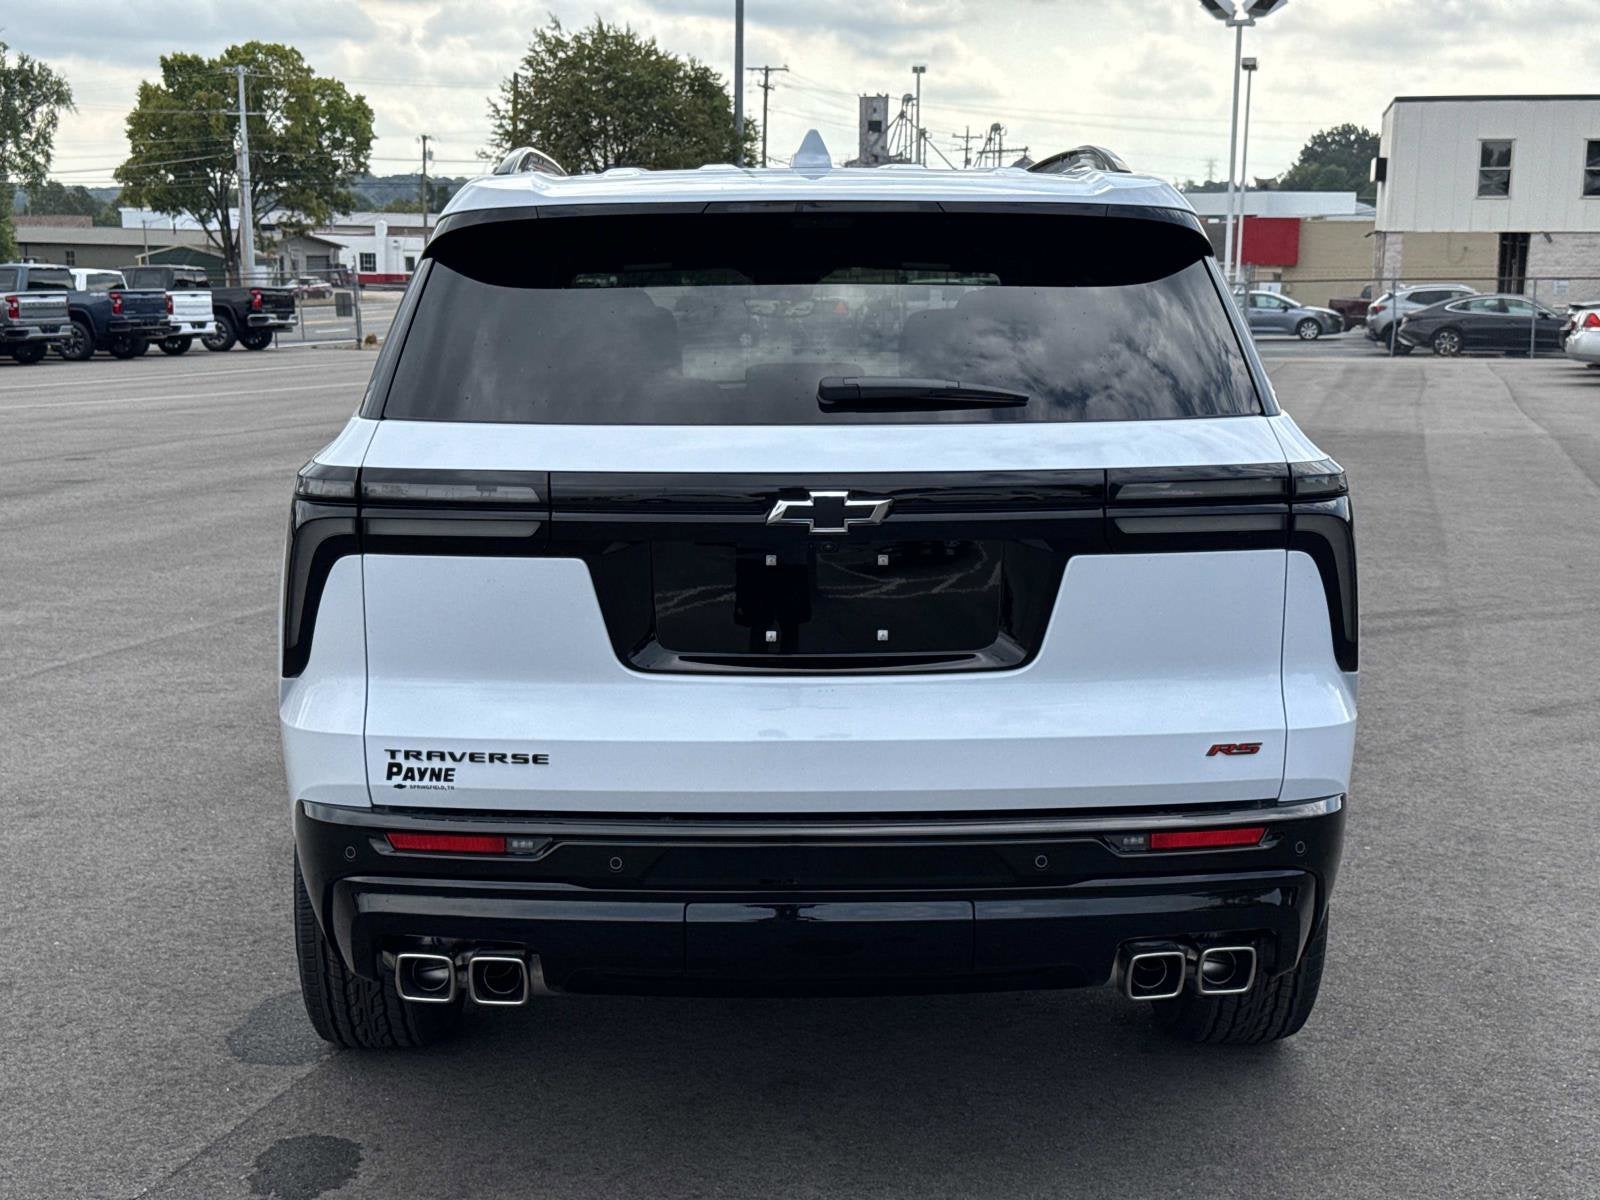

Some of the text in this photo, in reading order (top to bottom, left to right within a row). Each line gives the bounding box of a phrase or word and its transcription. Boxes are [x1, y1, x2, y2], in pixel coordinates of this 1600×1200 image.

[384, 749, 549, 765] TRAVERSE
[1206, 742, 1263, 757] RS
[386, 762, 456, 782] PAYNE
